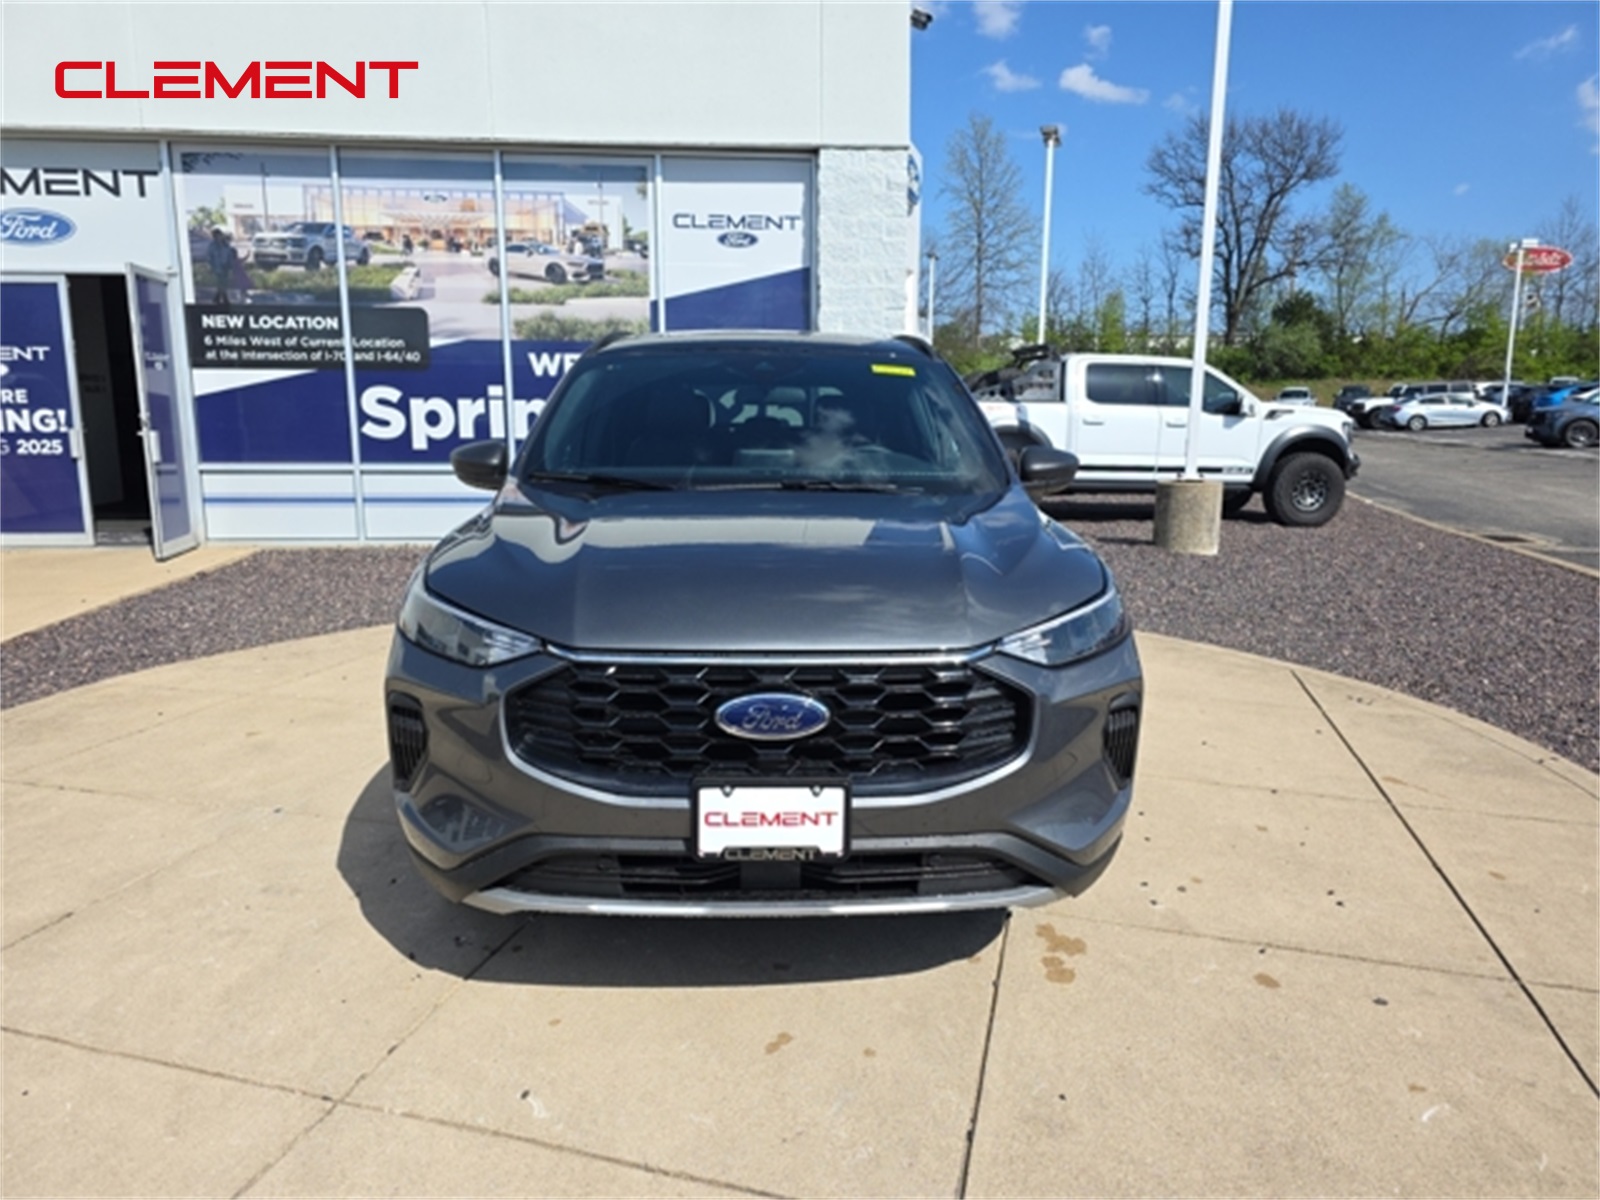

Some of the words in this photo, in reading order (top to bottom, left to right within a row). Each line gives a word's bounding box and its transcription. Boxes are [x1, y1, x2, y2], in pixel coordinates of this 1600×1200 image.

[0, 168, 159, 197] MENT
[0, 214, 58, 239] Ford
[672, 213, 802, 230] CLEMENT
[202, 314, 245, 329] NEW
[249, 314, 339, 331] LOCATION
[204, 335, 213, 346] 6
[215, 335, 247, 347] Miles
[249, 335, 282, 347] West
[283, 335, 299, 347] of
[352, 337, 406, 348] Location
[205, 349, 217, 360] at
[219, 349, 239, 360] the
[310, 350, 322, 361] of
[353, 351, 375, 361] and
[16, 438, 64, 455] 2025
[741, 703, 803, 730] Ford
[704, 811, 838, 827] CLEMENT
[724, 848, 817, 861] CLEMENT
